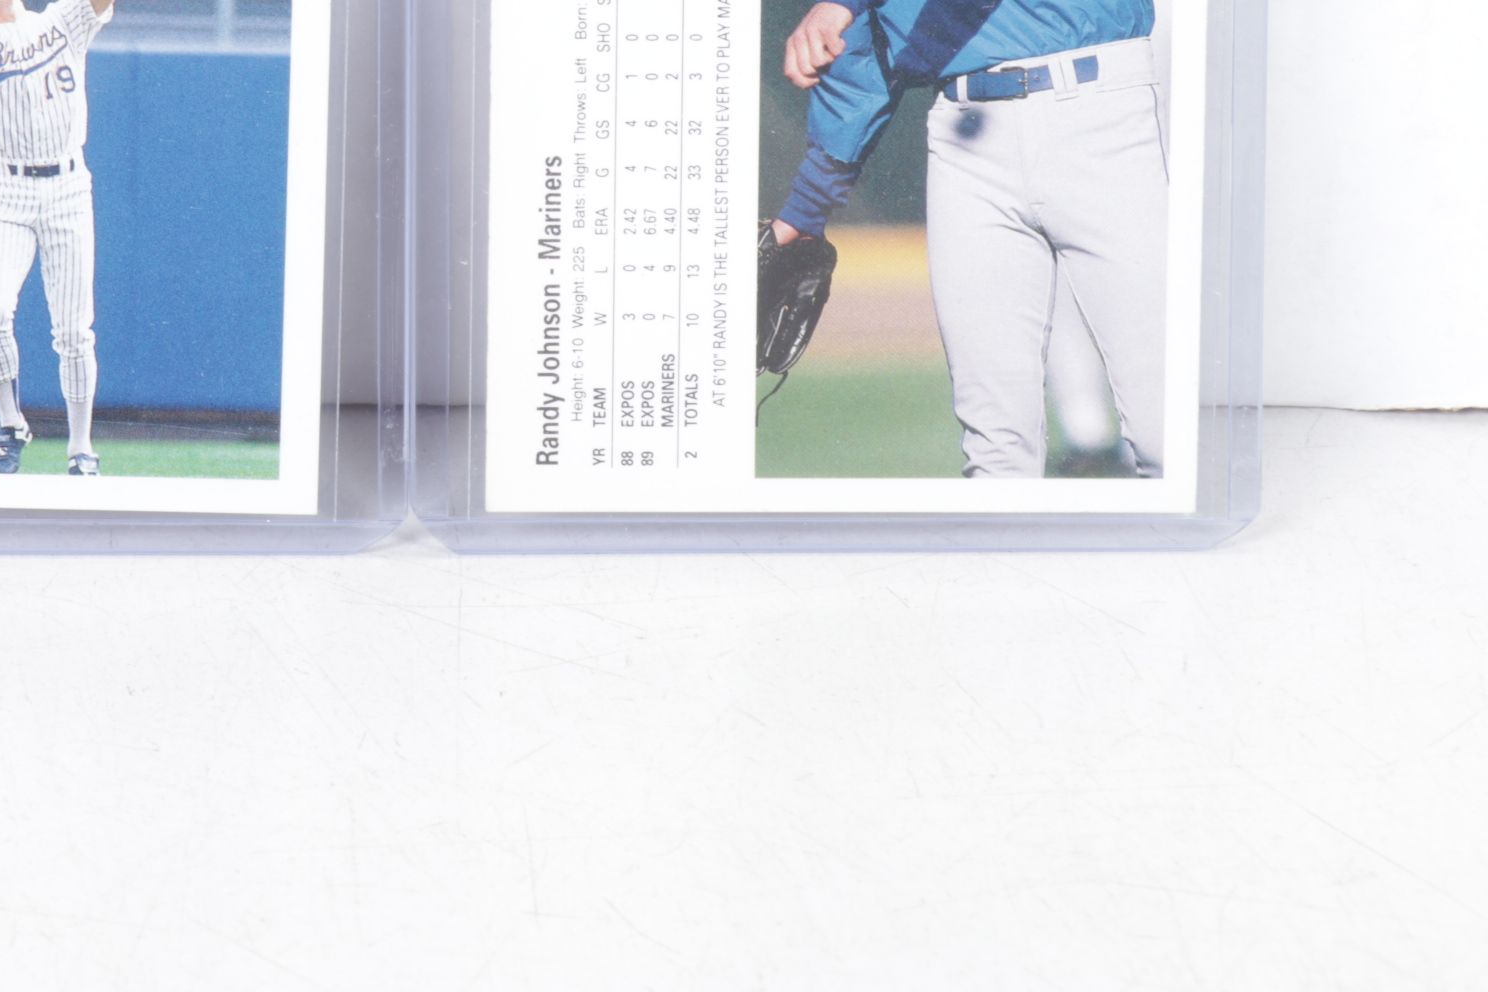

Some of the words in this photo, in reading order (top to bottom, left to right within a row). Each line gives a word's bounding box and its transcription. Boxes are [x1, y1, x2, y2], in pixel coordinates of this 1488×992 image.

[575, 4, 588, 39] Born:
[718, 24, 731, 58] PLAY
[44, 65, 76, 99] 19
[575, 57, 588, 84] Left
[717, 63, 730, 80] TO
[574, 89, 587, 144] Throws:
[716, 87, 730, 122] EVER
[573, 152, 588, 188] Right
[716, 126, 730, 183] PERSON
[538, 156, 563, 260] Mariners
[573, 194, 586, 229] Bats:
[715, 189, 729, 247] TALLEST
[573, 246, 585, 272] 225
[714, 252, 728, 276] THE
[572, 277, 587, 329] Weight:
[714, 283, 727, 295] IS
[537, 284, 561, 384] Johnson
[713, 300, 727, 349] RANDY
[571, 337, 584, 369] 6-10
[571, 374, 586, 422] Height:
[593, 387, 606, 427] TEAM
[621, 380, 635, 427] EXPOS
[641, 380, 655, 427] EXPOS
[661, 354, 675, 427] MARINERS
[685, 374, 699, 427] TOTALS
[713, 390, 726, 407] AT
[536, 393, 565, 466] Randy
[621, 451, 634, 466] 88
[641, 451, 654, 466] 89
